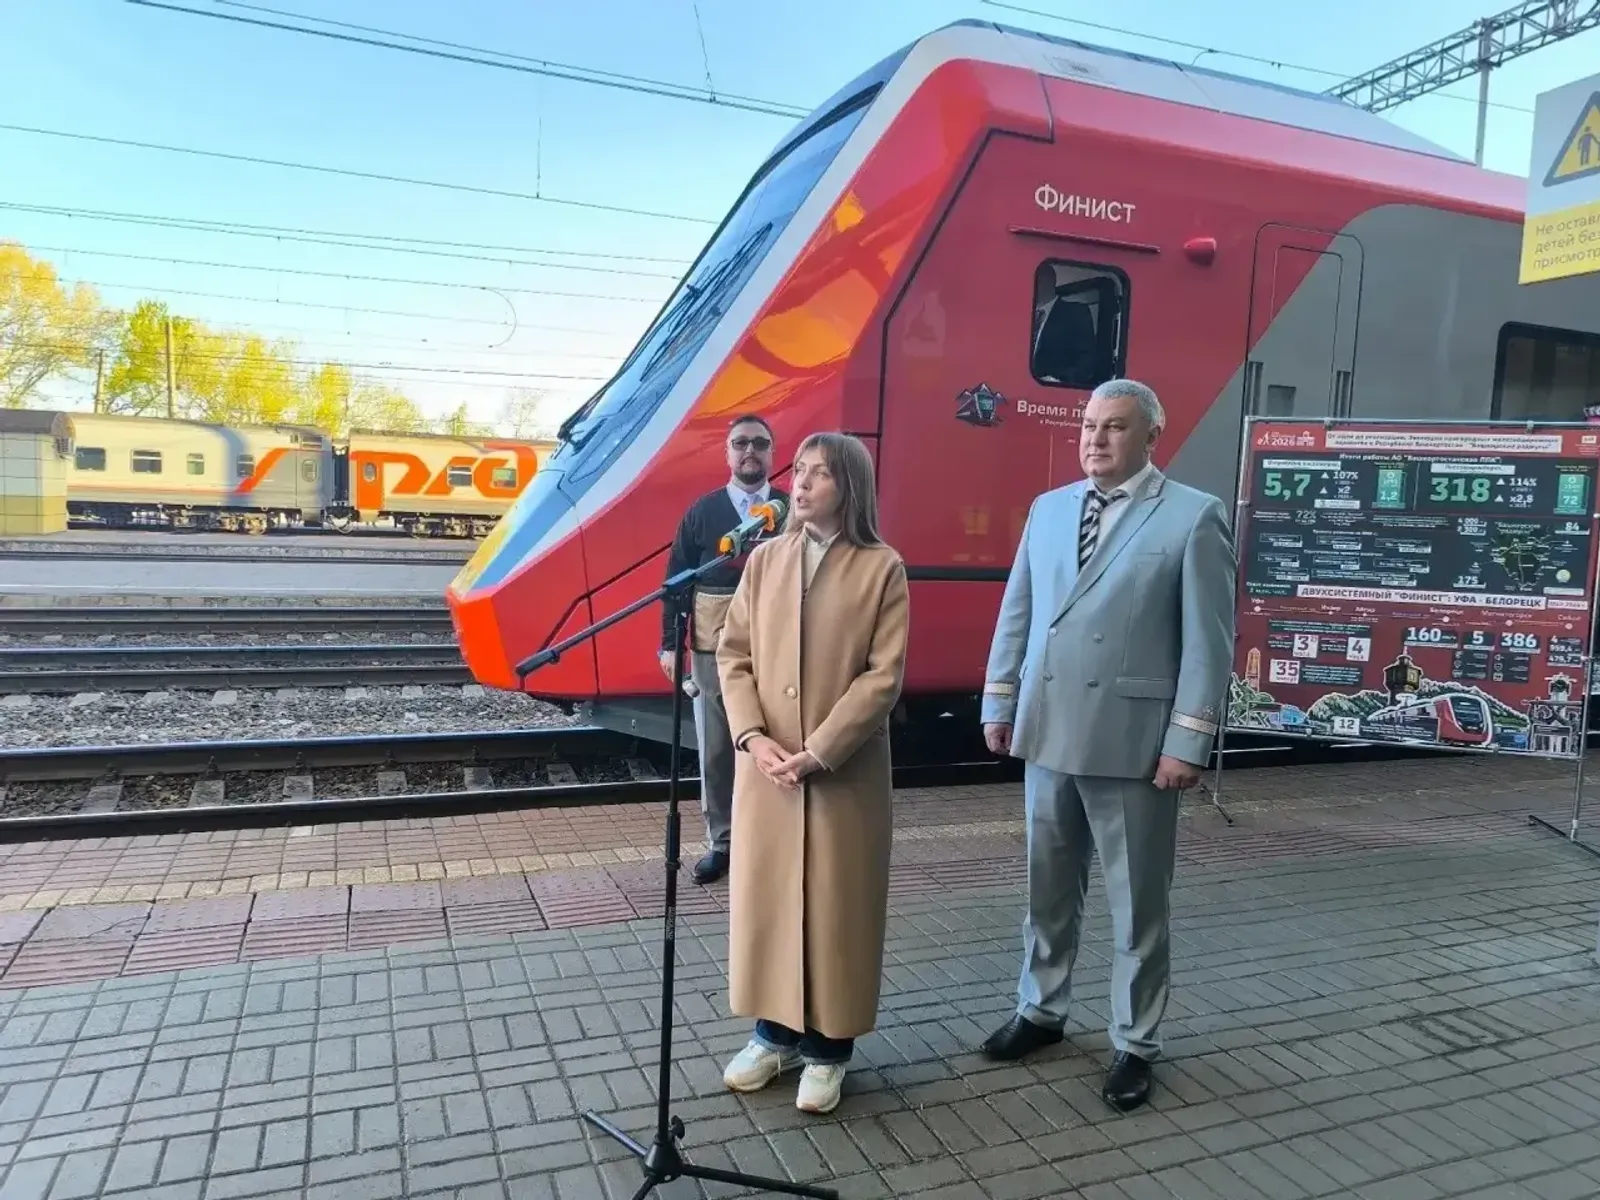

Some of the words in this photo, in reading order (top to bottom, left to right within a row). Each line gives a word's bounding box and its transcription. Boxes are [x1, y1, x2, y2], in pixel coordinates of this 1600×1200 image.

[1535, 224, 1553, 236] Не
[1534, 233, 1575, 254] детей
[1016, 400, 1067, 417] Время
[1333, 471, 1358, 480] 107%
[1509, 477, 1537, 487] 114%
[1264, 472, 1311, 501] 5,7
[1430, 477, 1491, 502] 318
[1380, 491, 1398, 501] 1,2
[1562, 495, 1579, 505] 72
[1296, 510, 1316, 519] 72%
[1301, 587, 1392, 600] ДВУХСИСТЕМНЫЙ
[1453, 594, 1477, 604] УФА
[1485, 596, 1541, 608] БЕЛОРЕЦК
[1407, 627, 1441, 641] 160
[1472, 631, 1484, 644] 5
[1501, 632, 1537, 648] 386
[1297, 636, 1309, 651] 3
[1352, 640, 1364, 654] 4
[1276, 661, 1298, 676] 35
[1339, 719, 1355, 730] 12
